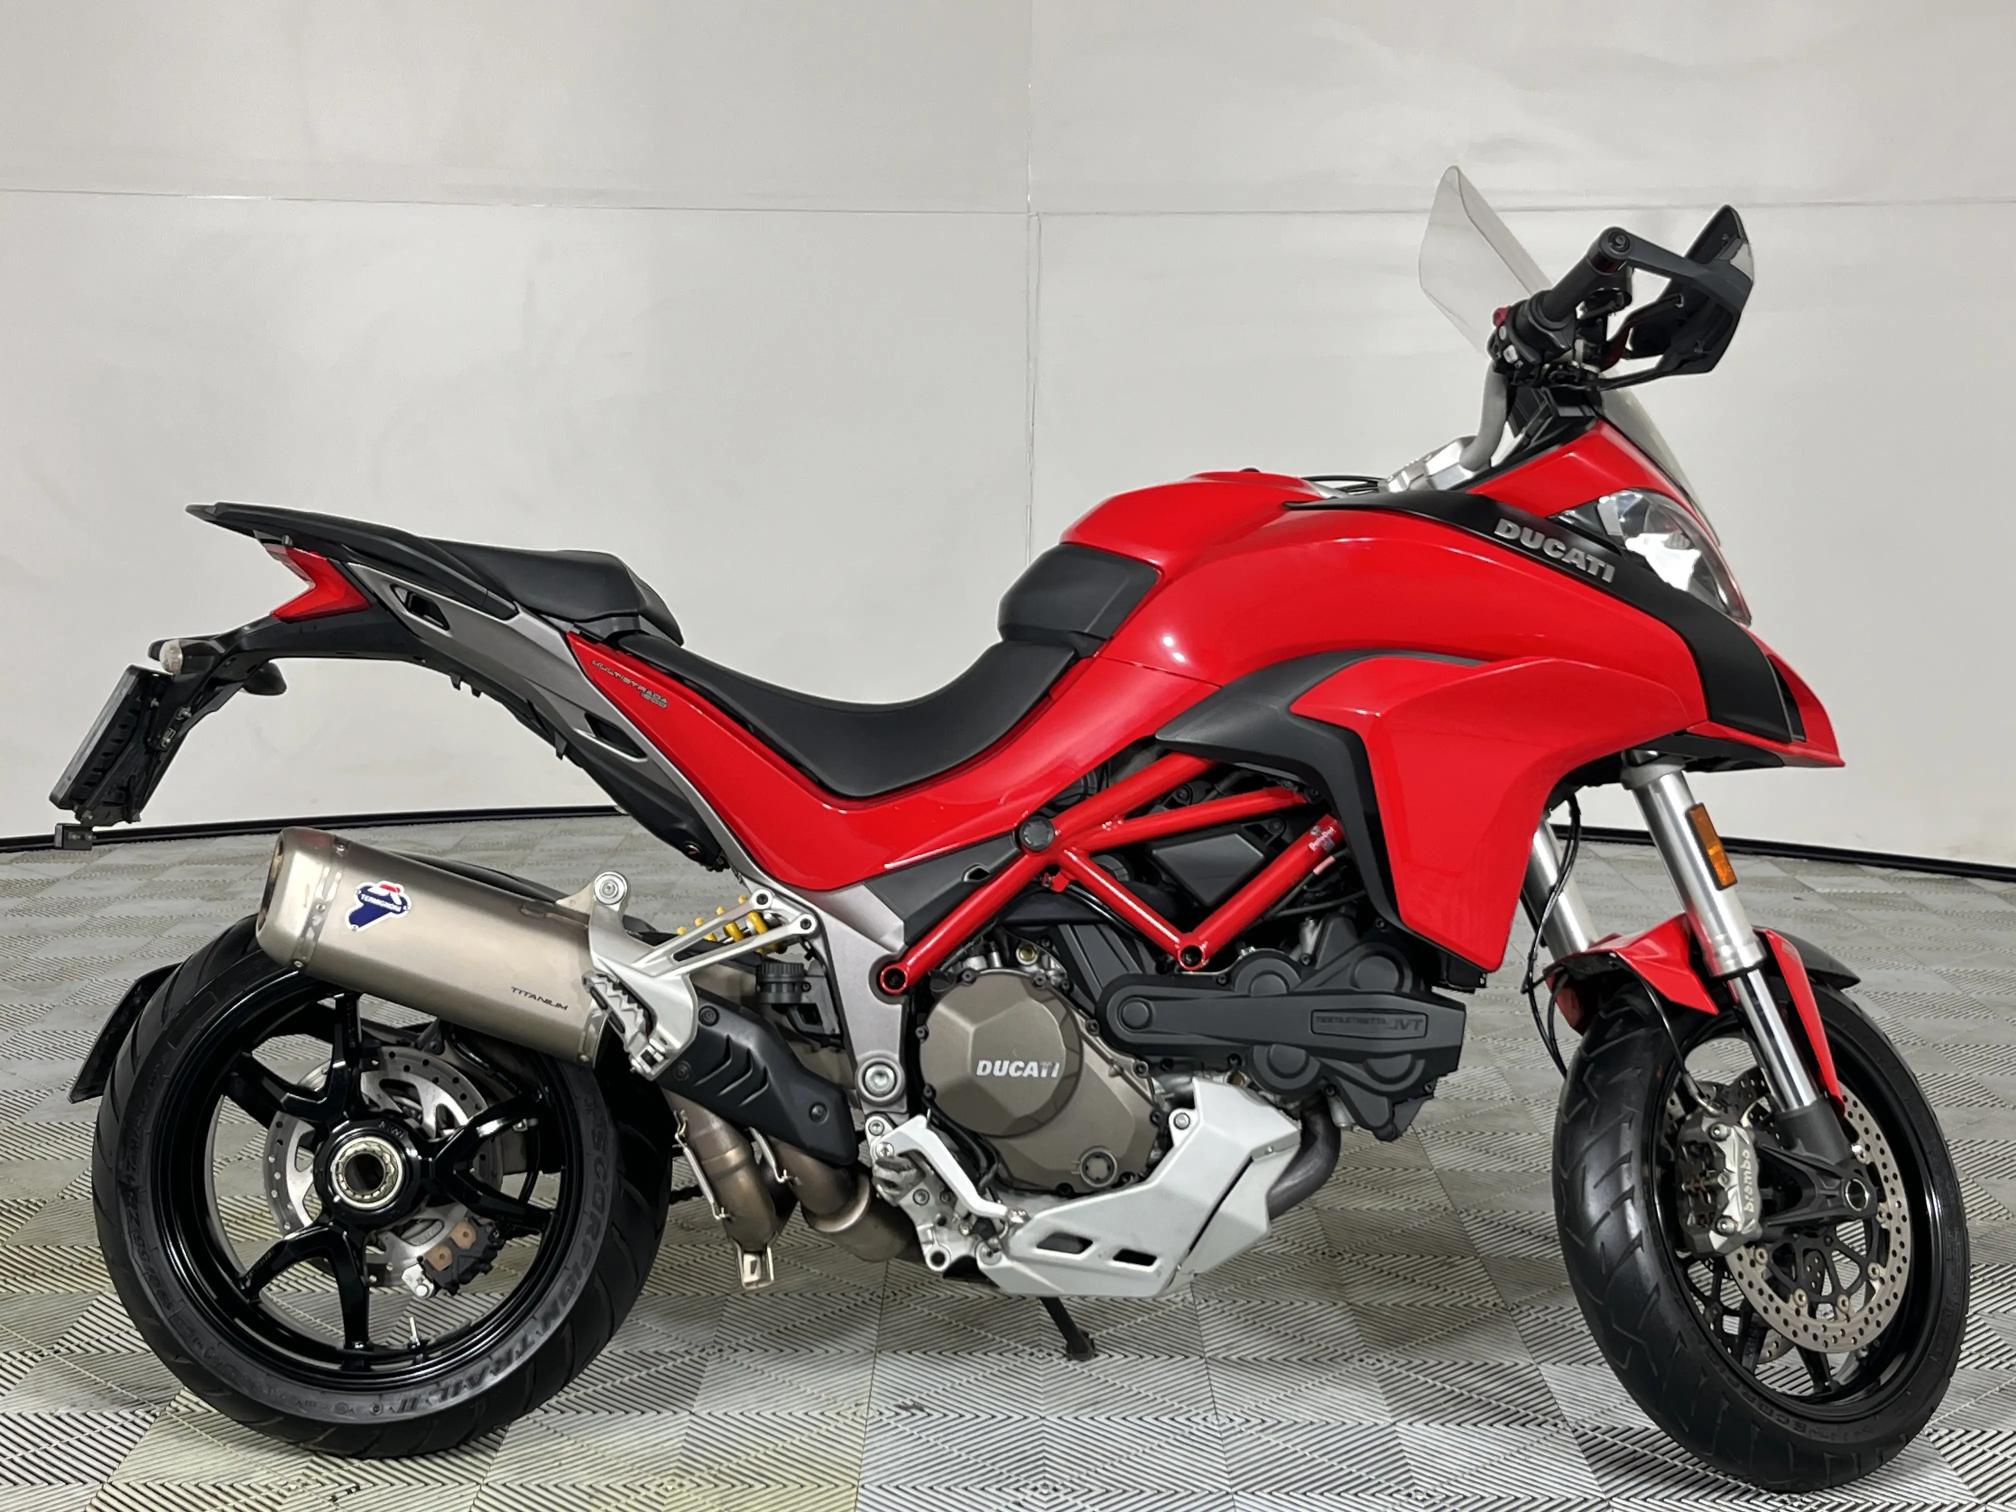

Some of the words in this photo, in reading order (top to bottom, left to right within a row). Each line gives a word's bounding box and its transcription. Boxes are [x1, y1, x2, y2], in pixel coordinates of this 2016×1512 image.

[1494, 518, 1616, 583] DUCATI
[592, 660, 668, 703] MULTISTRADA
[511, 986, 568, 1010] TITANIUM
[976, 1060, 1060, 1078] DUCATI
[1740, 1149, 1755, 1213] brembo
[541, 1127, 608, 1327] SCORPION
[428, 1332, 537, 1403] TRAIL
